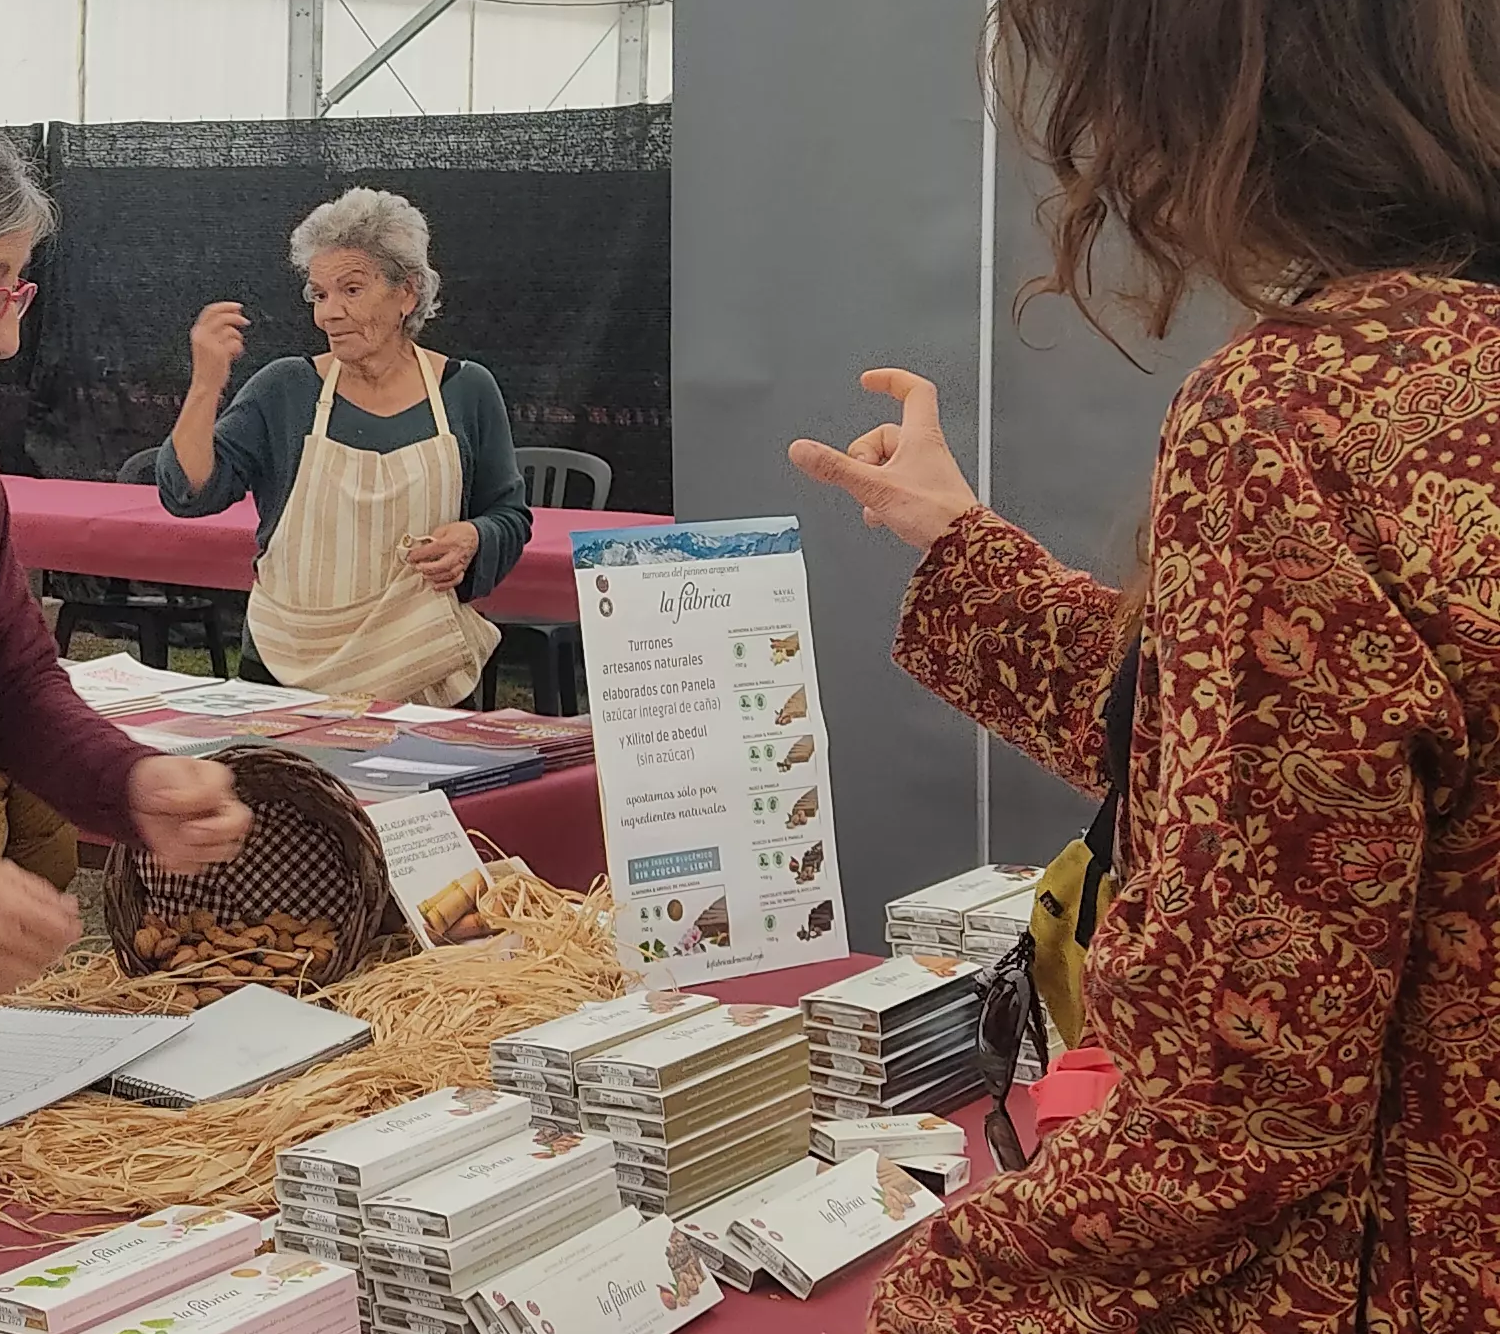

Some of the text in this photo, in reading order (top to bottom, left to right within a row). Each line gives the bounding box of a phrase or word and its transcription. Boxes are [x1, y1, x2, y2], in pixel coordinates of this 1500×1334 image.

[642, 568, 670, 580] turrones
[671, 566, 682, 577] del
[683, 566, 708, 580] pirineo
[660, 591, 673, 613] la
[628, 637, 673, 652] Turrones
[603, 654, 703, 675] artesanos naturales
[602, 678, 716, 702] elaborados con Panela
[602, 697, 721, 723] (azúcar integral de caña)
[619, 725, 708, 749] y Xilitol de abedul
[637, 747, 695, 767] (sin azúcar)
[626, 785, 718, 807] apostamos sólo por
[621, 803, 727, 829] ingredientes naturales
[596, 1295, 613, 1316] la
